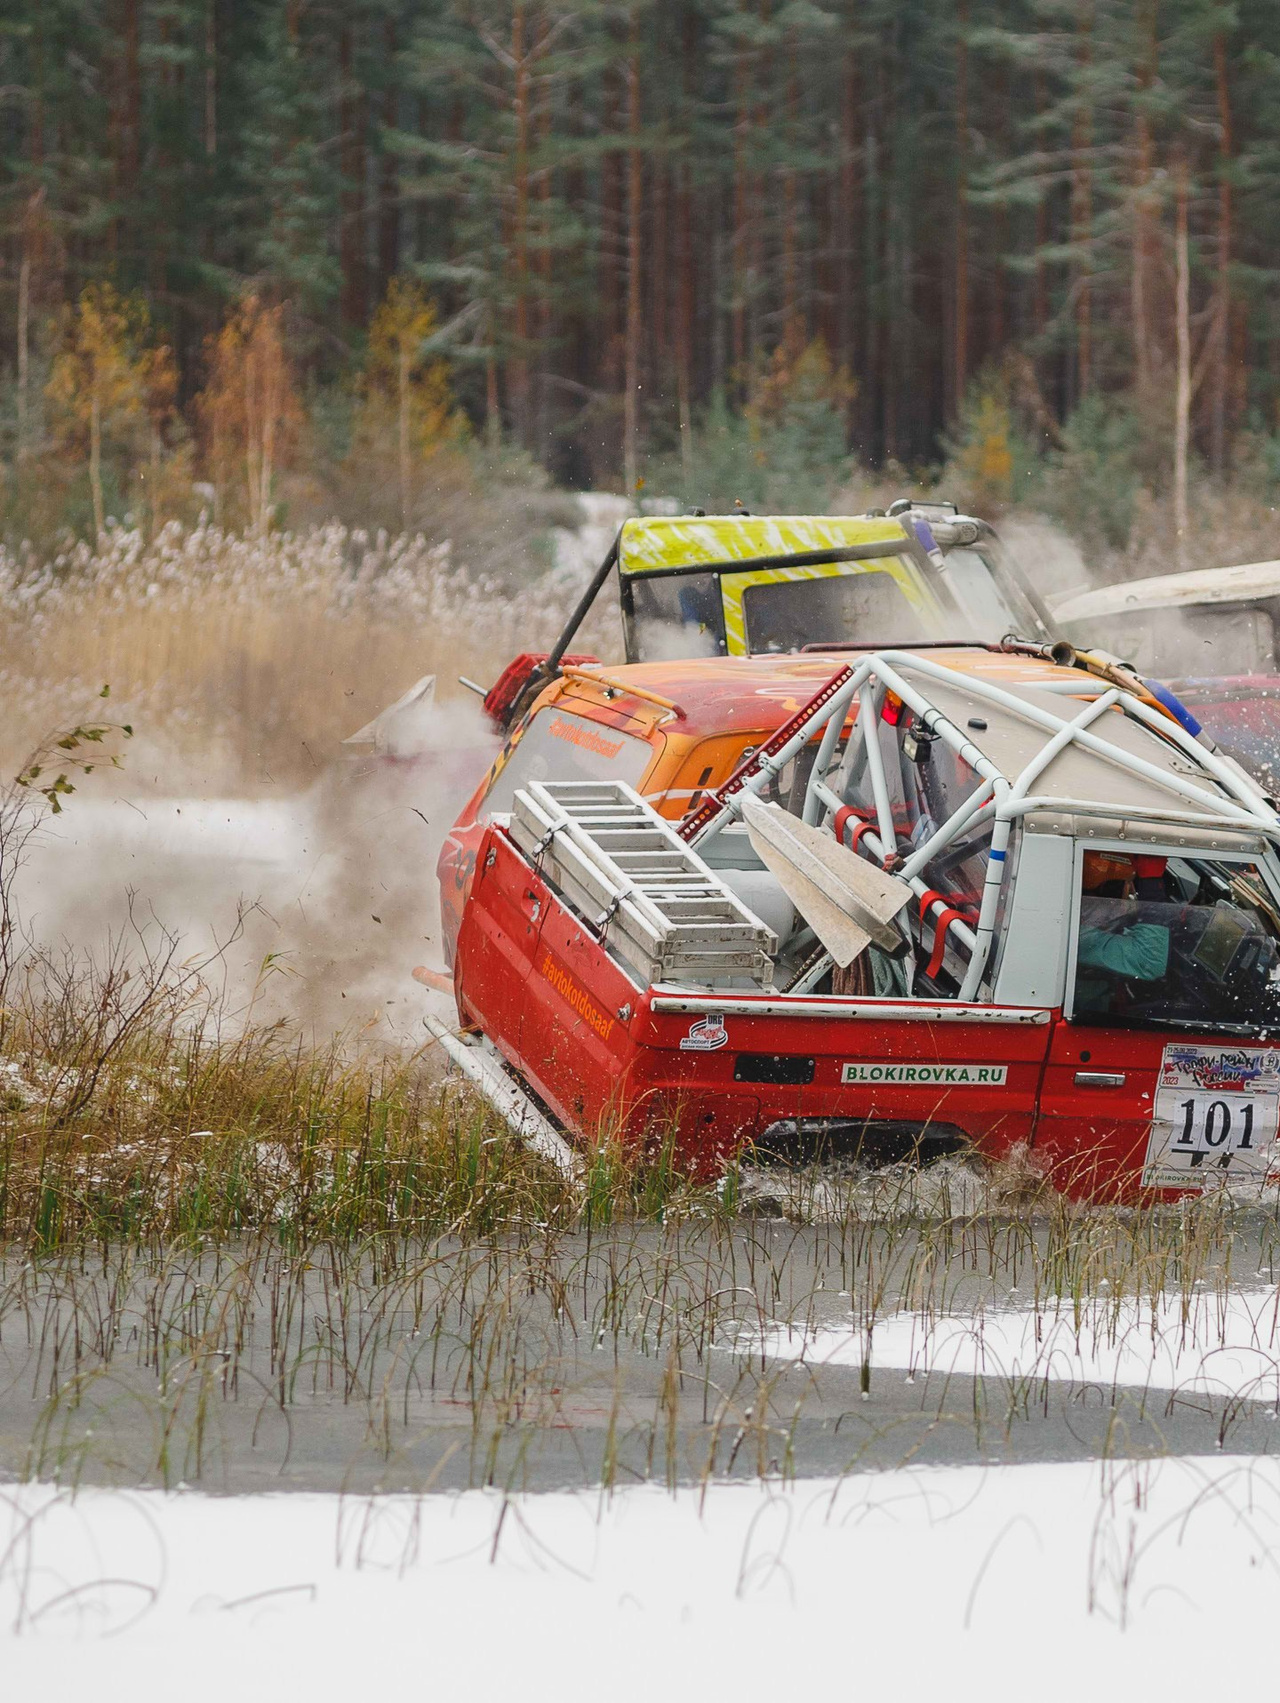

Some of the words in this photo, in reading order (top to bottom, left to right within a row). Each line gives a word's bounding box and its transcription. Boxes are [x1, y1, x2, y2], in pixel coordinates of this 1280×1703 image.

[542, 954, 615, 1040] #avtokotdosaaf
[847, 1067, 1003, 1082] BLOKIROVKA.RU
[1162, 1077, 1179, 1086] 2023
[1177, 1099, 1253, 1149] 101
